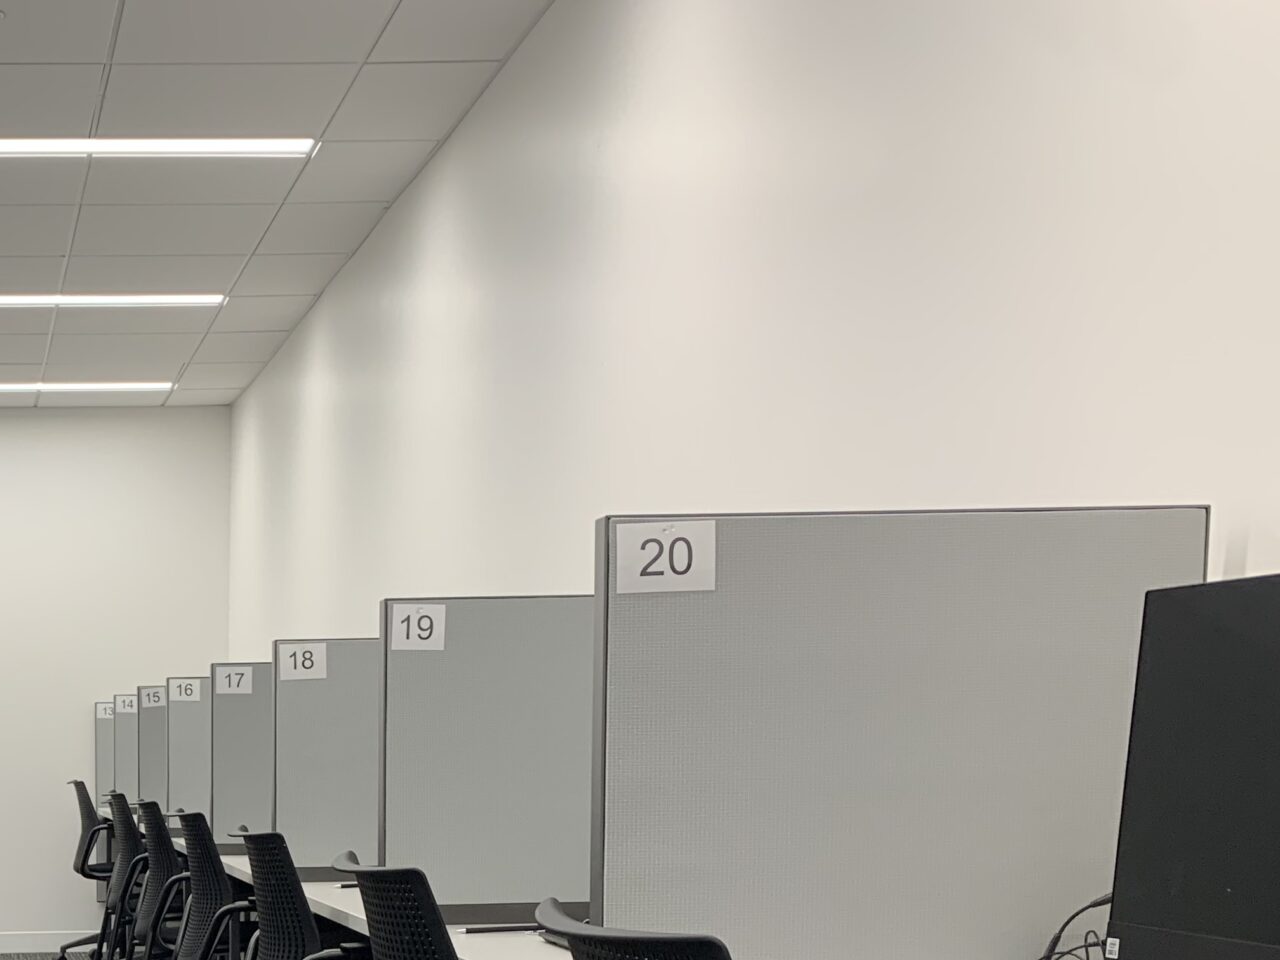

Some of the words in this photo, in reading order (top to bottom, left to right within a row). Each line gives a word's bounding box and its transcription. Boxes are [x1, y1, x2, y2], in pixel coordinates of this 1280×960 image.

[639, 536, 693, 577] 20
[400, 614, 434, 641] 19
[289, 650, 314, 670] 18
[224, 672, 245, 689] 17
[145, 691, 160, 704] 15
[176, 683, 193, 697] 16
[121, 699, 134, 709] 14
